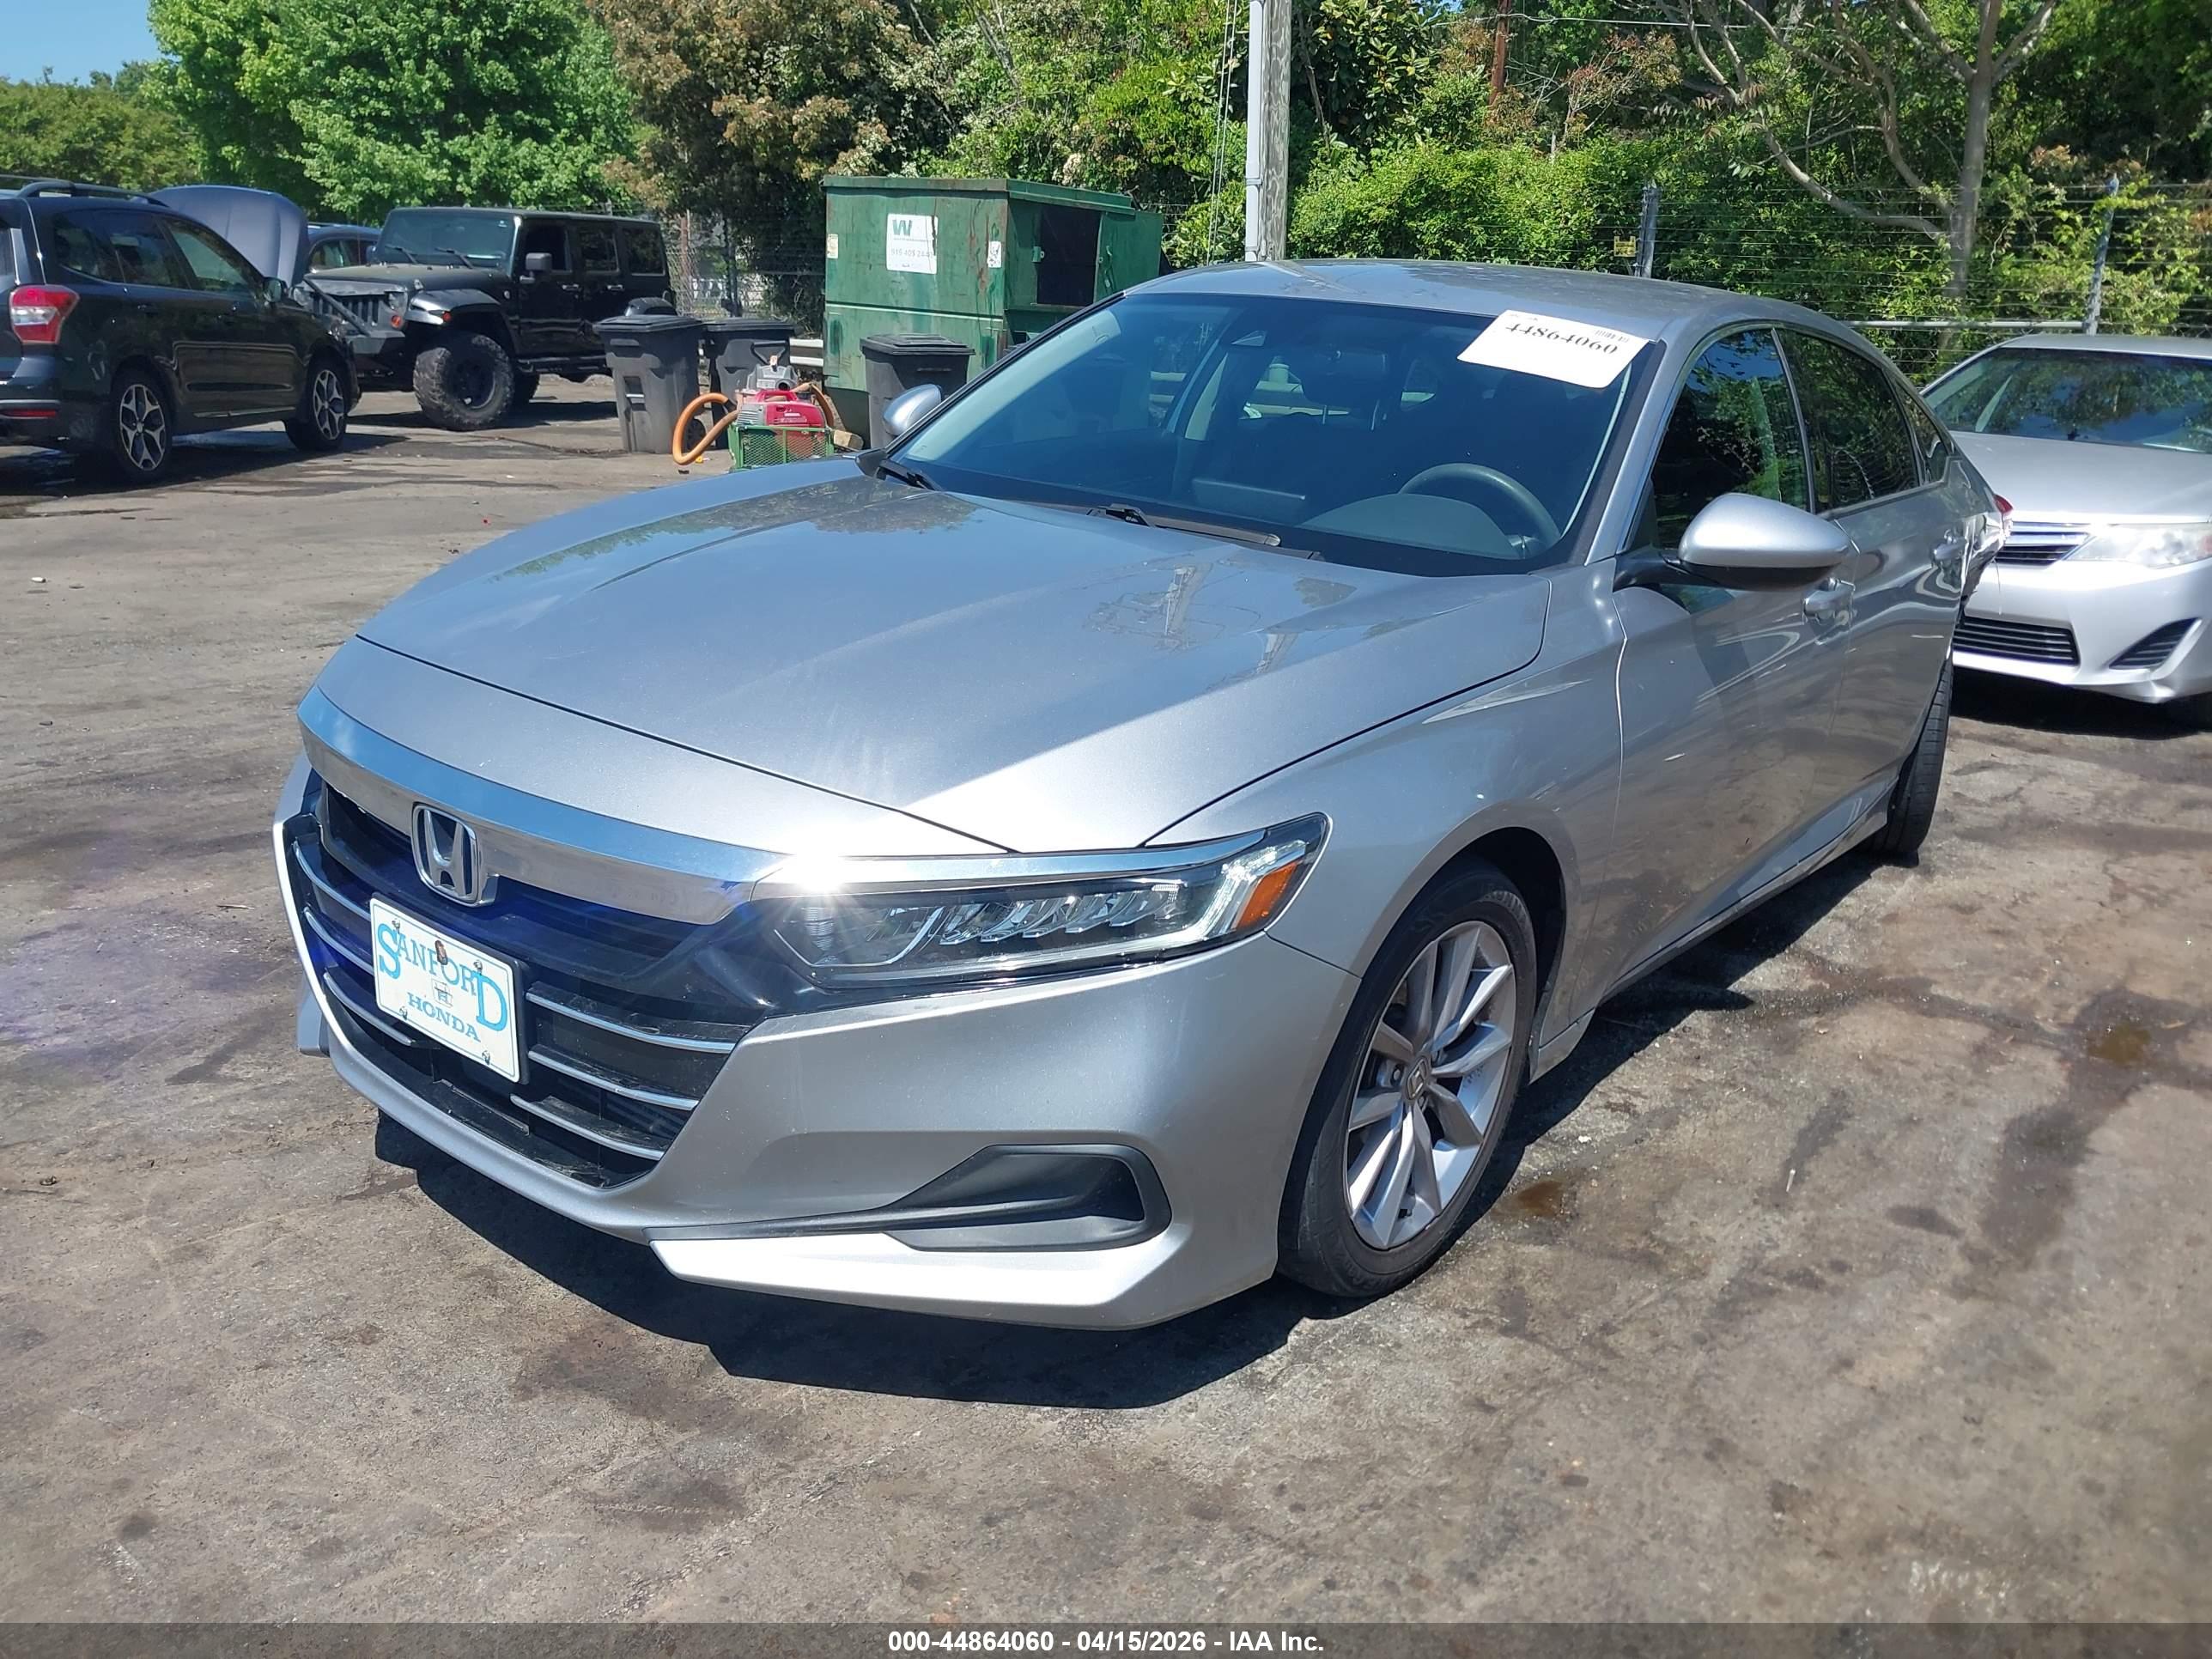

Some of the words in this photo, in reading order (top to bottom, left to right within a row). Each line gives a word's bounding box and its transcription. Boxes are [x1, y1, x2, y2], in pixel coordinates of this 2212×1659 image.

[1505, 323, 1619, 355] 44864060
[377, 922, 508, 1032] SANFORD
[407, 992, 481, 1042] HONDA
